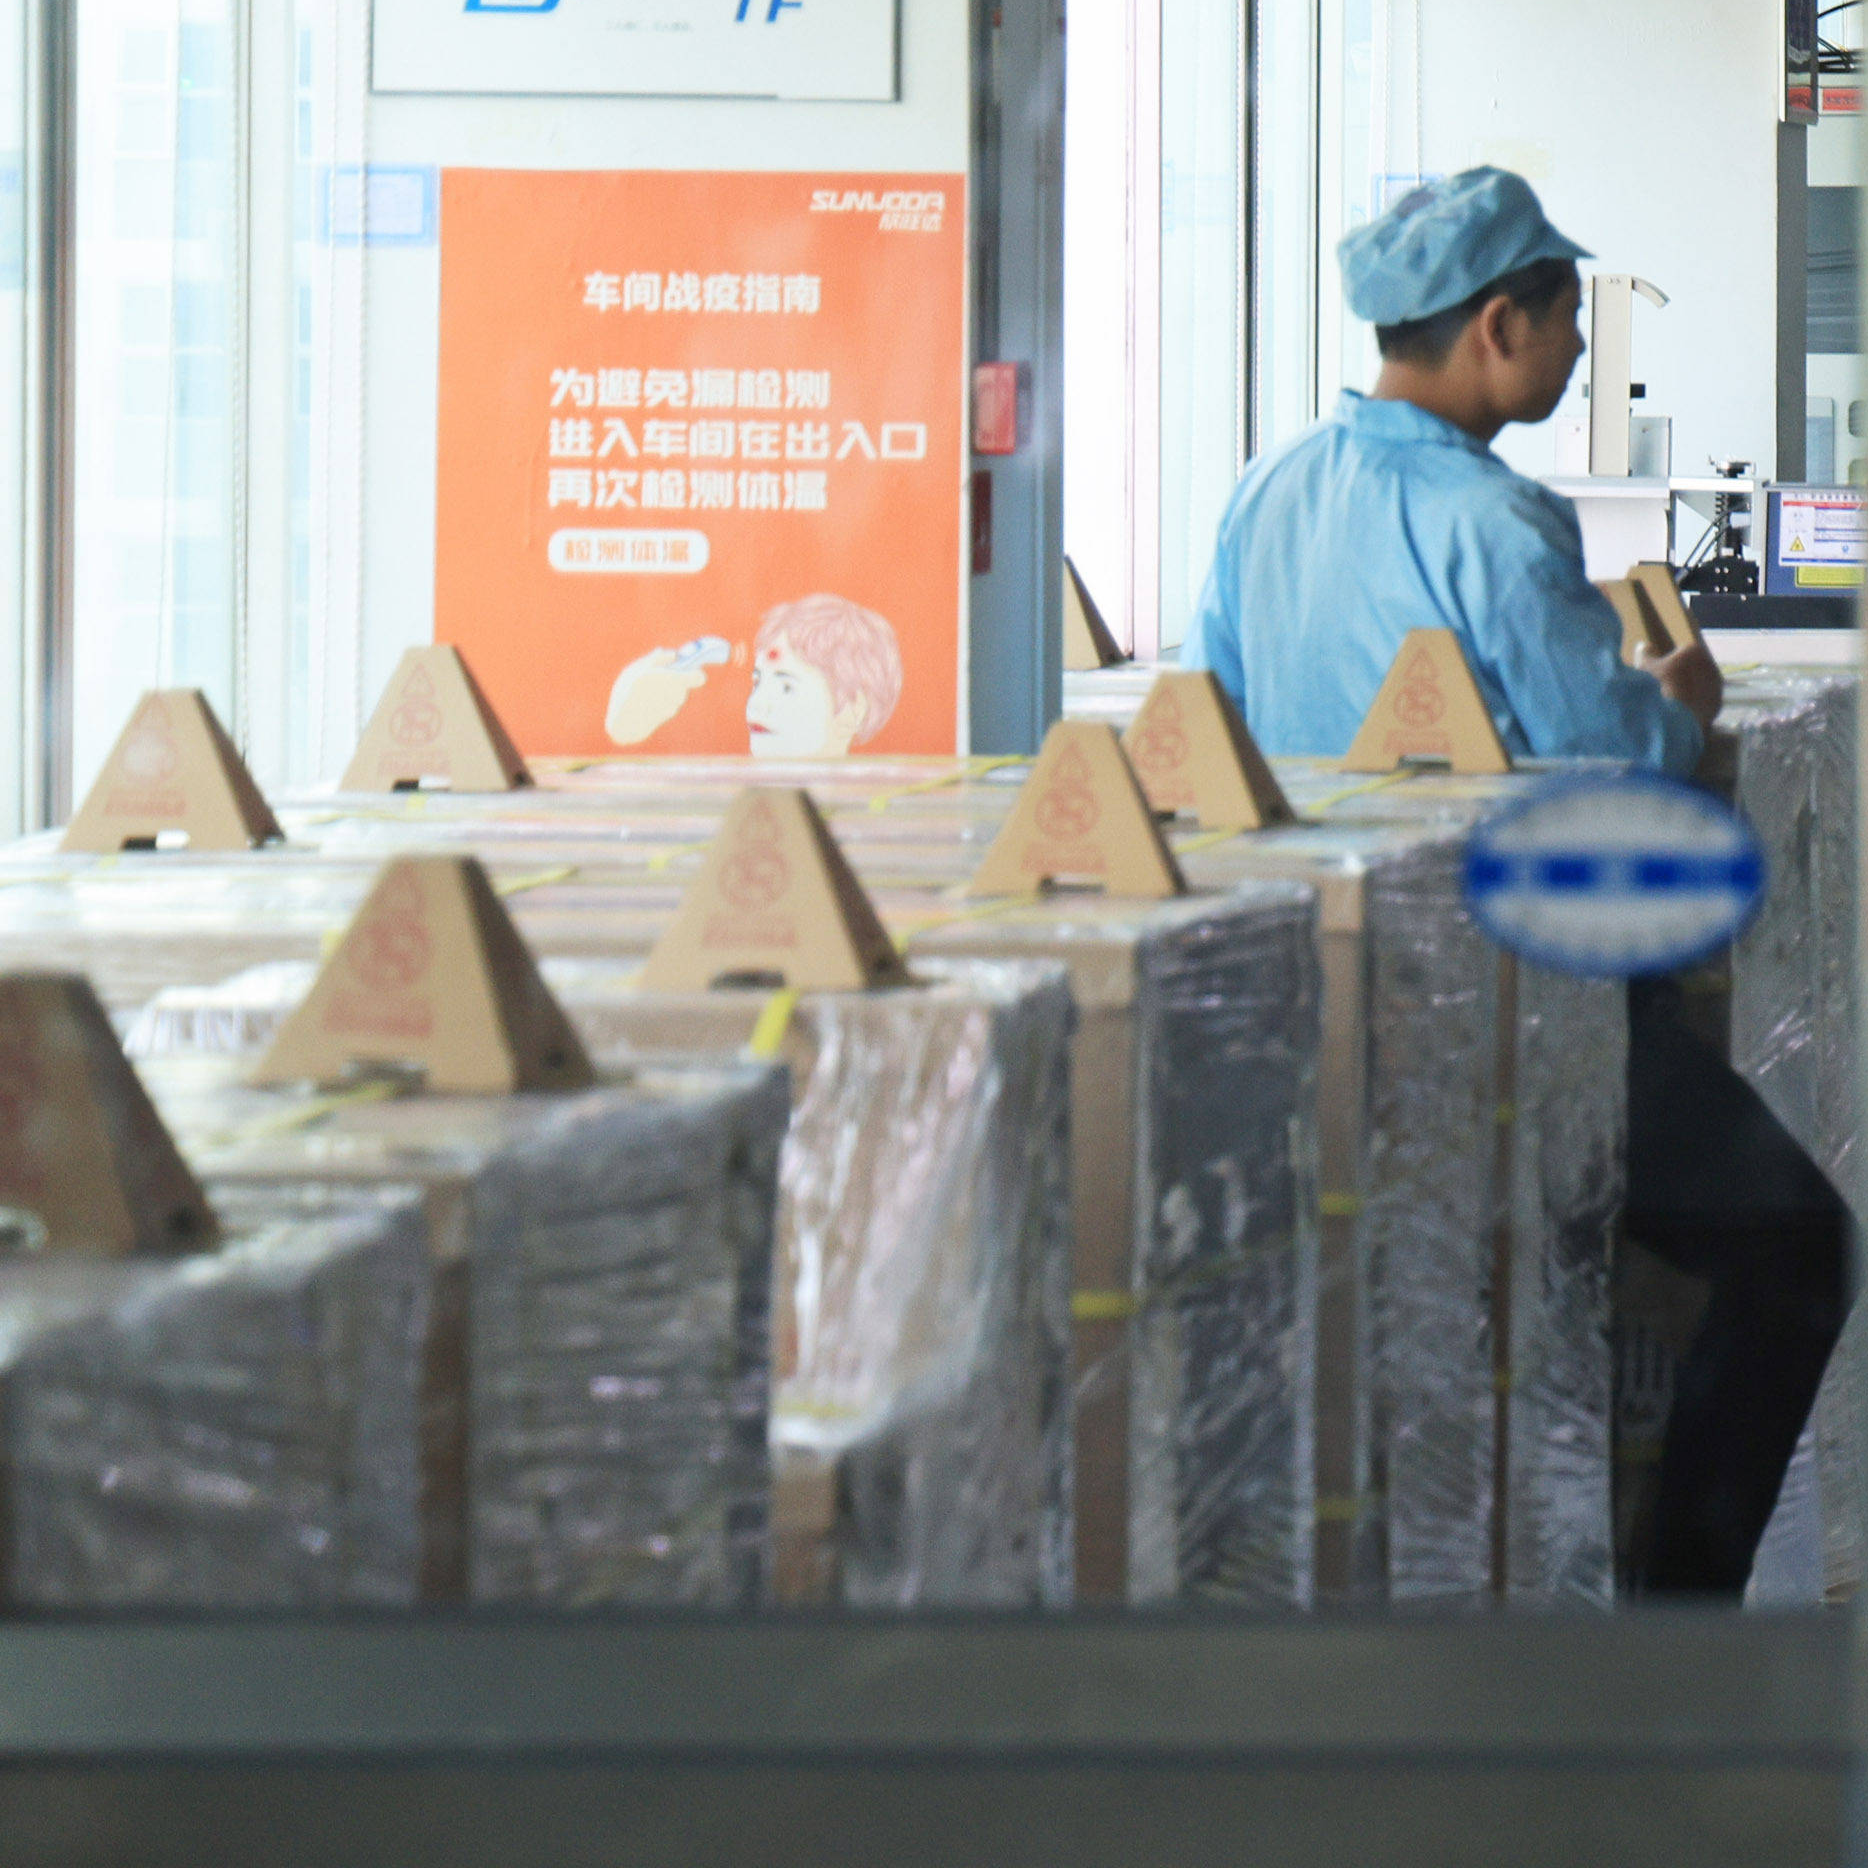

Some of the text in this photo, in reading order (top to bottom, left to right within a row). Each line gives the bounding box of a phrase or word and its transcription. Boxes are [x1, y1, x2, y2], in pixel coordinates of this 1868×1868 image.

[809, 191, 946, 211] SUNWODA
[583, 271, 822, 314] 车间战疫指南
[550, 368, 831, 410] 为避免漏检测
[548, 418, 927, 461] 进入车间在出入口
[547, 468, 828, 511] 再次检测体温
